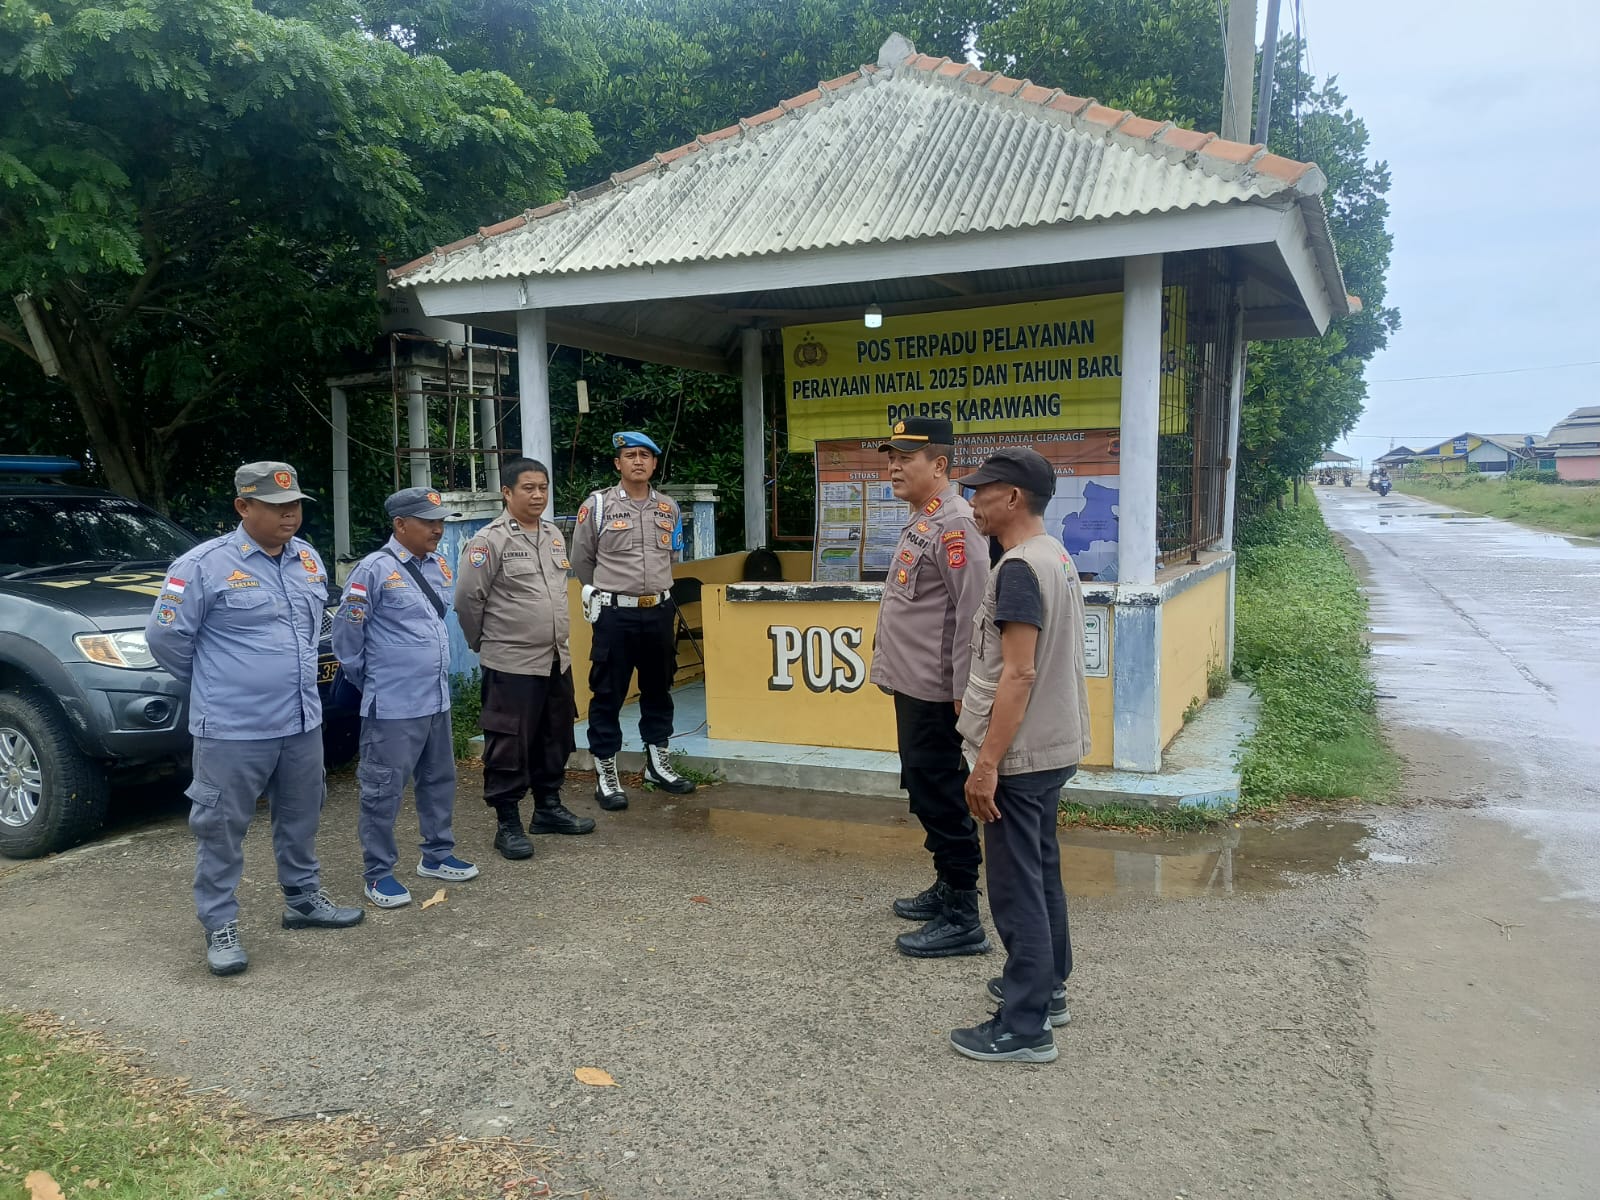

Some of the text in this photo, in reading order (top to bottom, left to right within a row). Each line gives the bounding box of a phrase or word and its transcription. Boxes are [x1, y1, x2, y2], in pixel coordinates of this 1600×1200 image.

[857, 319, 1095, 364] POS TERPADU PELAYANAN
[792, 374, 870, 400] PERAYAAN
[875, 370, 925, 394] NATAL
[929, 366, 968, 390] 2025
[973, 363, 1008, 387] DAN
[1012, 358, 1073, 384] TAHUN
[956, 393, 1061, 422] KARAWANG
[999, 434, 1034, 444] PANTAI
[1036, 432, 1085, 443] CIPARAGE
[906, 531, 929, 549] POLRI
[766, 625, 867, 694] POS
